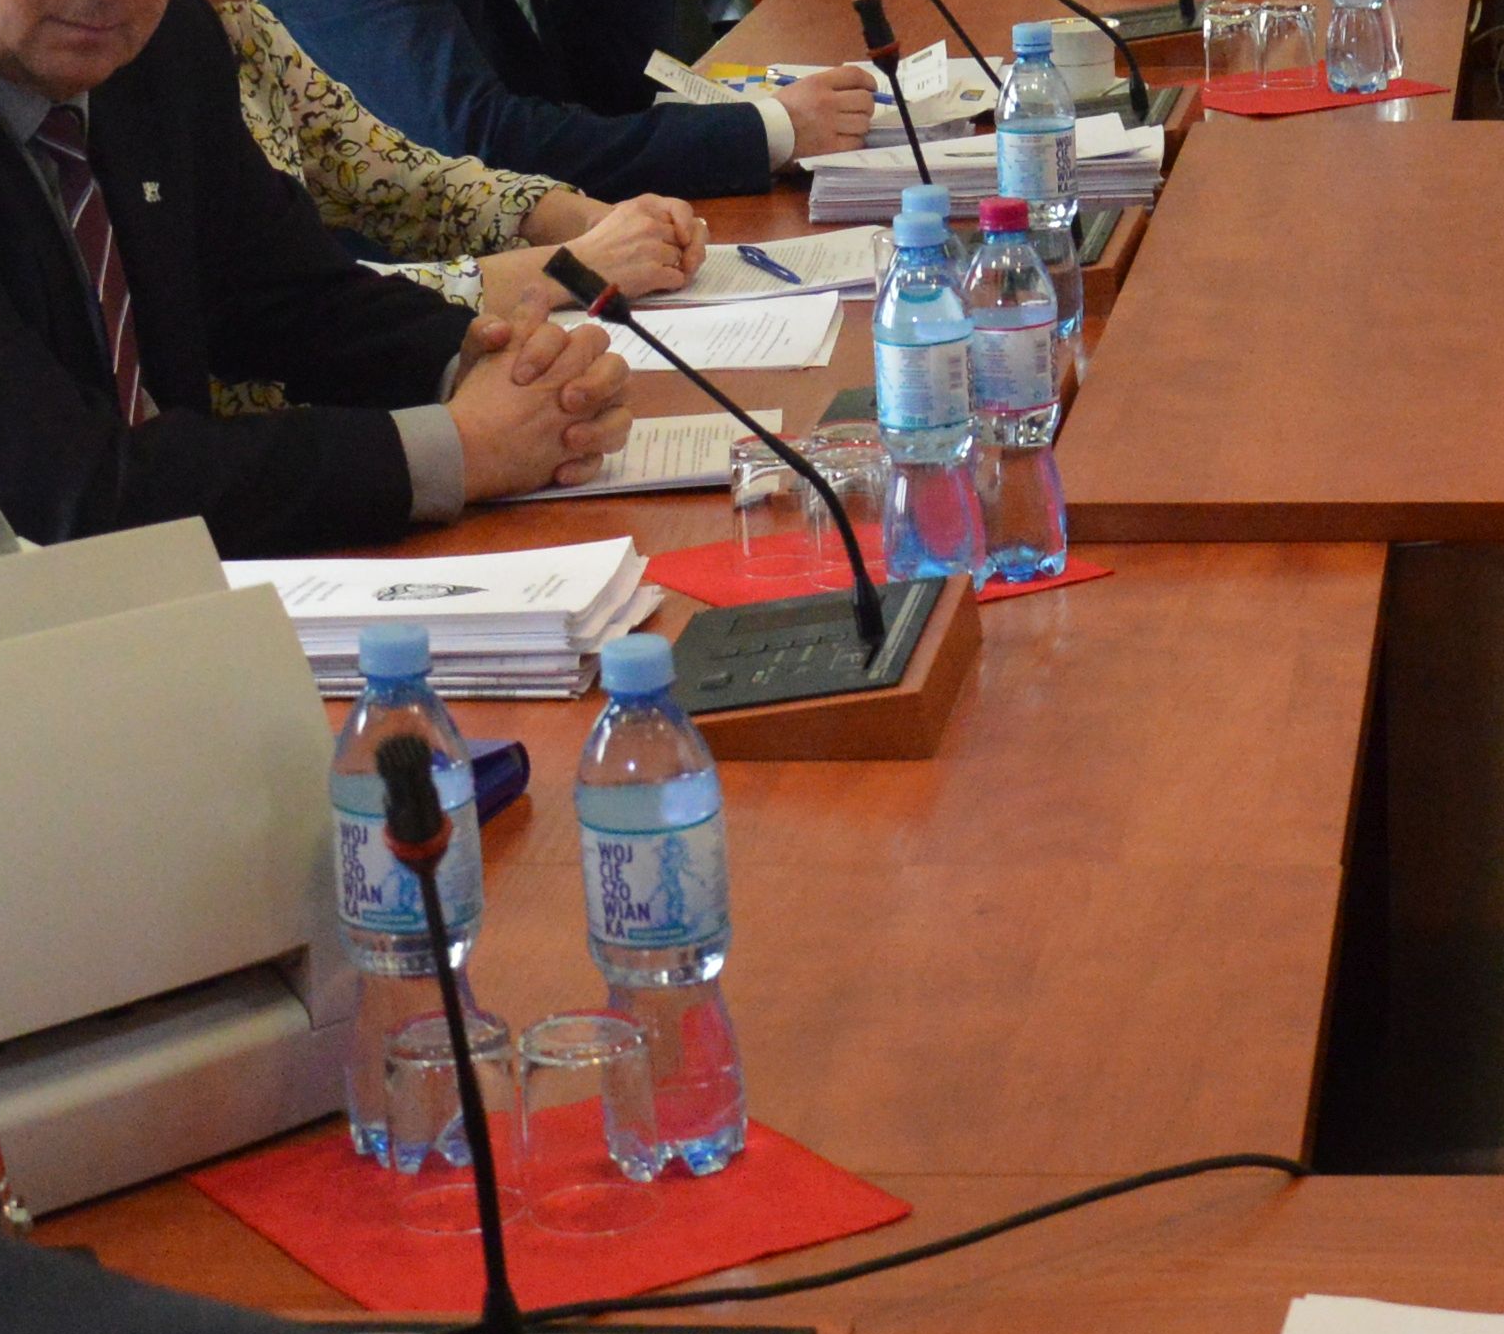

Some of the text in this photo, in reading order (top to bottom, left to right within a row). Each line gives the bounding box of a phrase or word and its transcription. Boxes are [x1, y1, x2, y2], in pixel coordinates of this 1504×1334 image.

[340, 821, 369, 845] WOJ
[598, 842, 633, 863] WOJ
[600, 861, 623, 880] CIE
[344, 880, 383, 905] WIAN
[602, 878, 631, 901] SZO
[345, 900, 360, 919] KA
[604, 898, 651, 921] WIAN
[605, 919, 625, 939] KA
